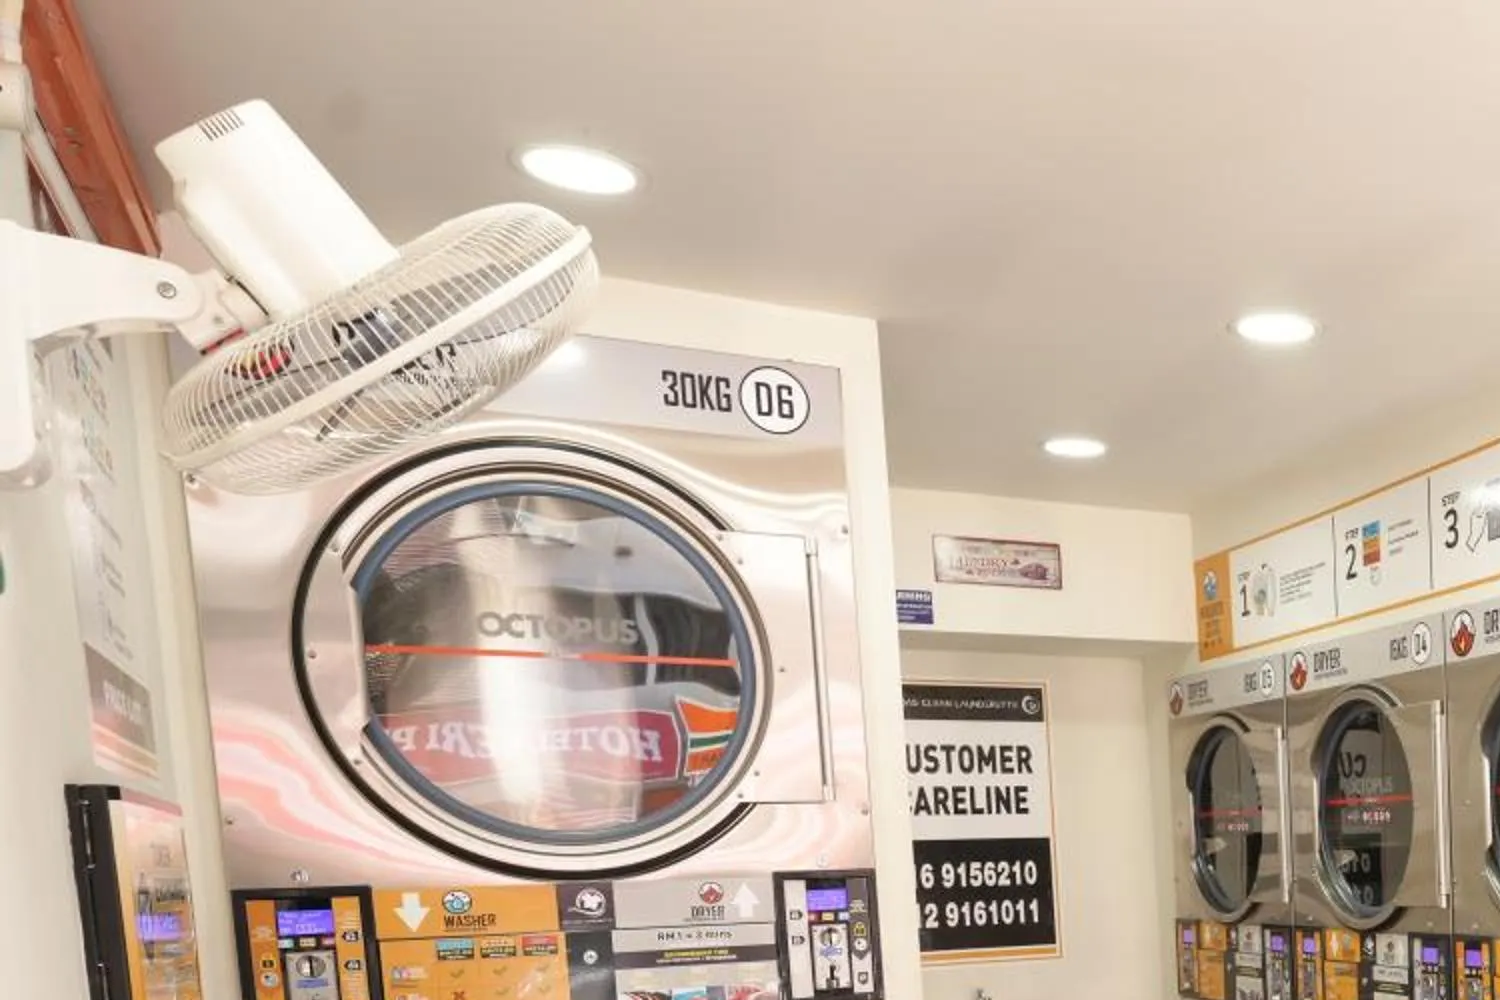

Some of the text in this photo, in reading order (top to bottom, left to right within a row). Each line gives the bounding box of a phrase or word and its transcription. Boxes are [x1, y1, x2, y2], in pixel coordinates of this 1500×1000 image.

[661, 370, 733, 412] 30KG
[755, 381, 795, 419] D6
[1442, 508, 1459, 549] 3
[1345, 543, 1358, 581] 2
[1240, 584, 1251, 616] 1
[477, 610, 640, 646] OCTOPUS
[905, 744, 1033, 775] USTOMER
[909, 786, 1030, 816] ARELINE
[919, 859, 1037, 889] 6 9156210
[443, 913, 497, 928] WASHER
[945, 898, 1040, 928] 9161011
